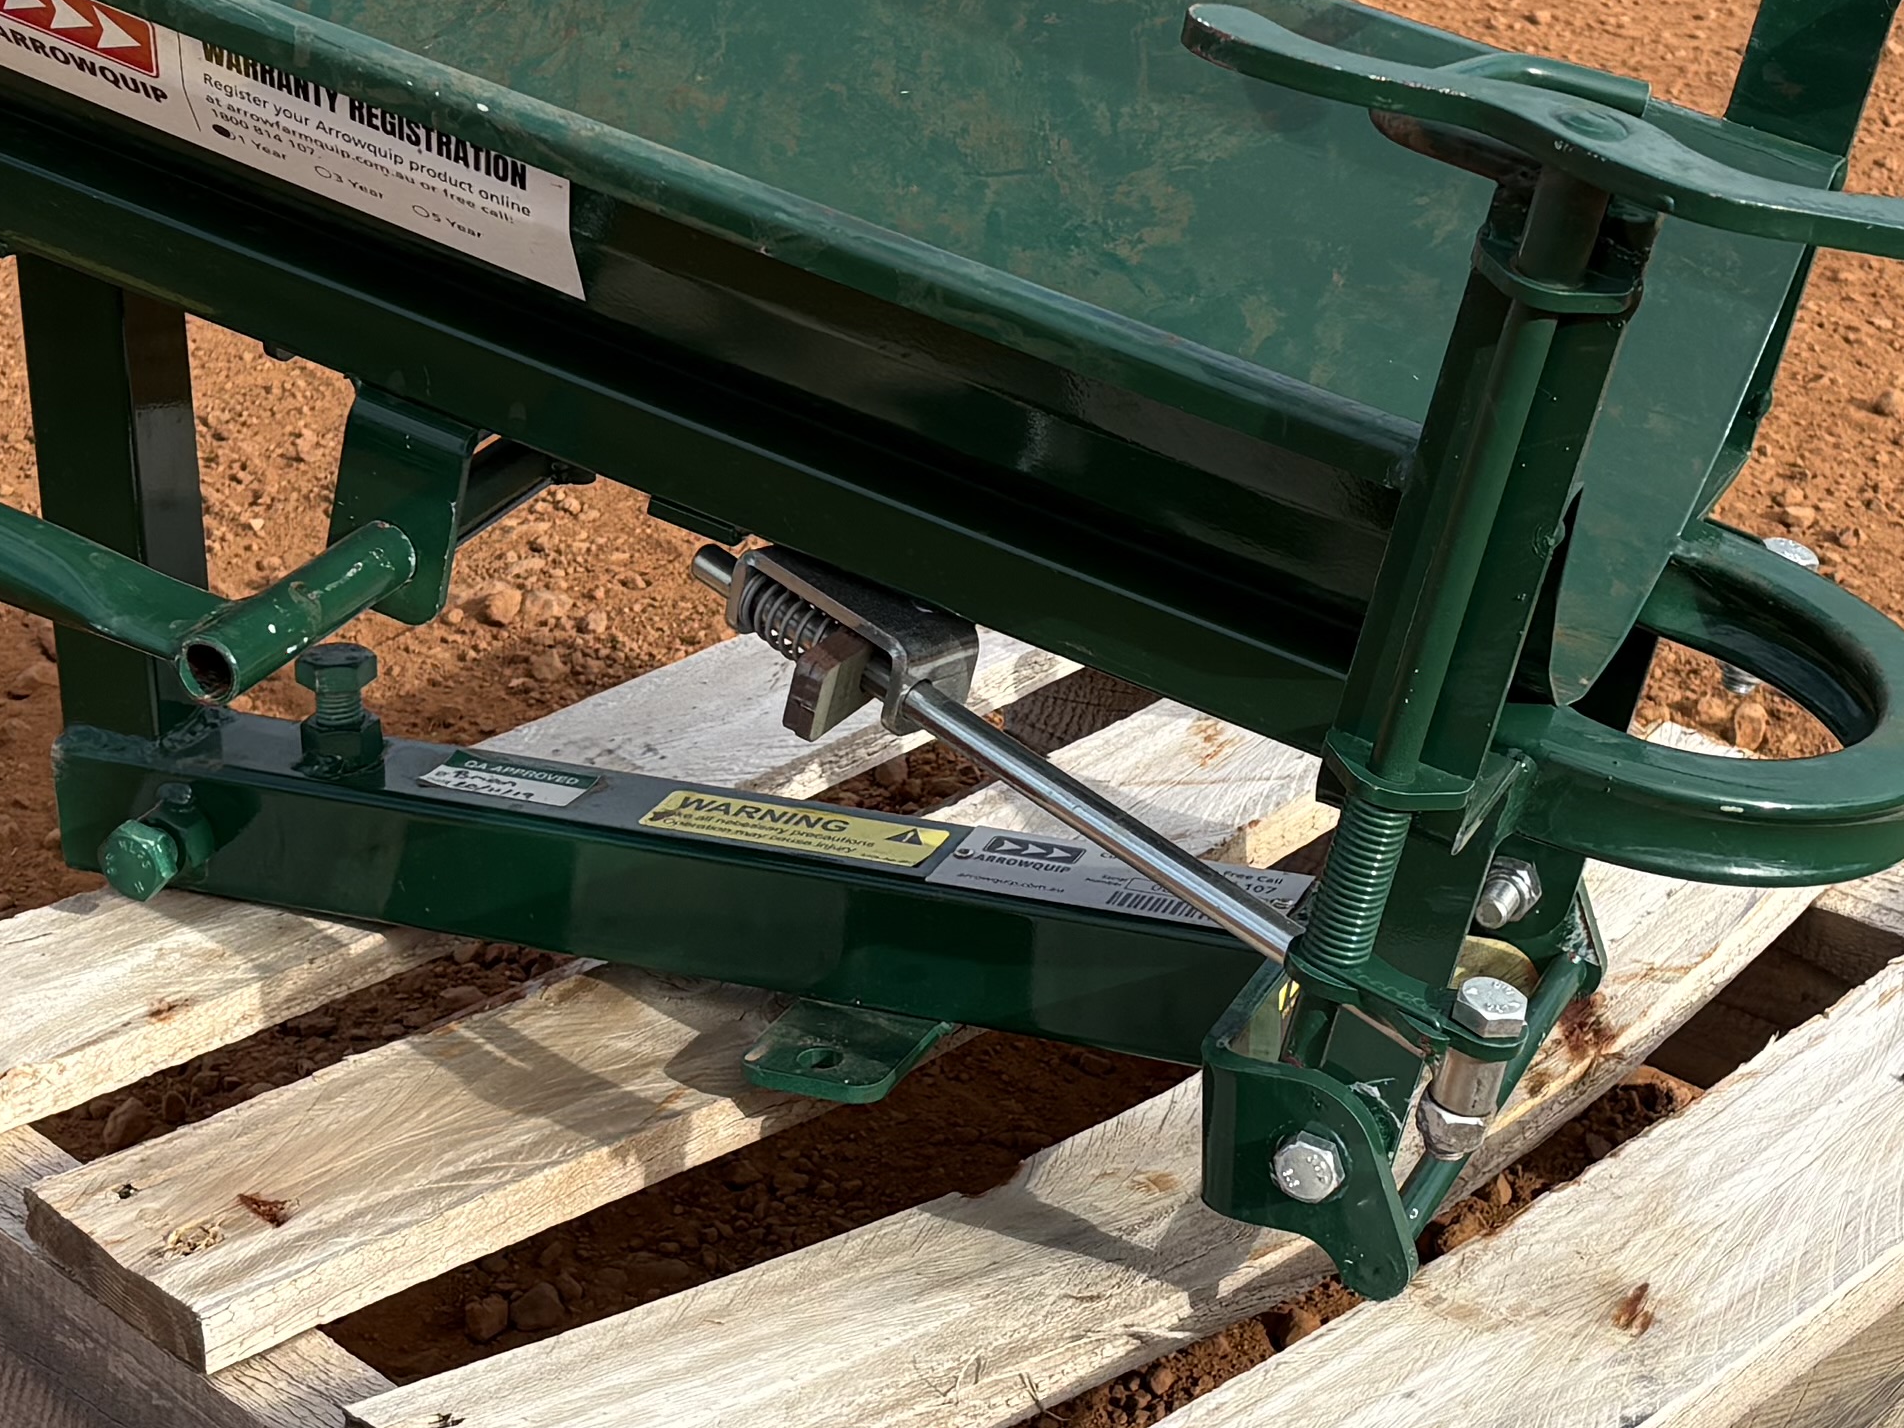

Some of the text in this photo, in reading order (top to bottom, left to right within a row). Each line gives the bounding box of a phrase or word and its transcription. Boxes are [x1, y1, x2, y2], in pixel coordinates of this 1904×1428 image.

[211, 108, 249, 130] 1800
[253, 124, 283, 144] 814
[203, 73, 532, 217] Register your Arrowquip product online
[205, 94, 223, 108] at
[226, 104, 416, 185] arrowfarmquip.com.au
[419, 180, 439, 193] or
[443, 187, 477, 209] free
[251, 139, 287, 161] Year
[348, 96, 528, 191] REGISTRATION
[348, 178, 384, 200] Year
[445, 219, 483, 239] Year
[463, 759, 580, 786] QA APPROVED
[679, 795, 850, 833] WARNING
[789, 828, 876, 848] precautions
[814, 840, 858, 853] injury
[974, 852, 1072, 874] ARROWQUIP
[1257, 875, 1284, 885] Call
